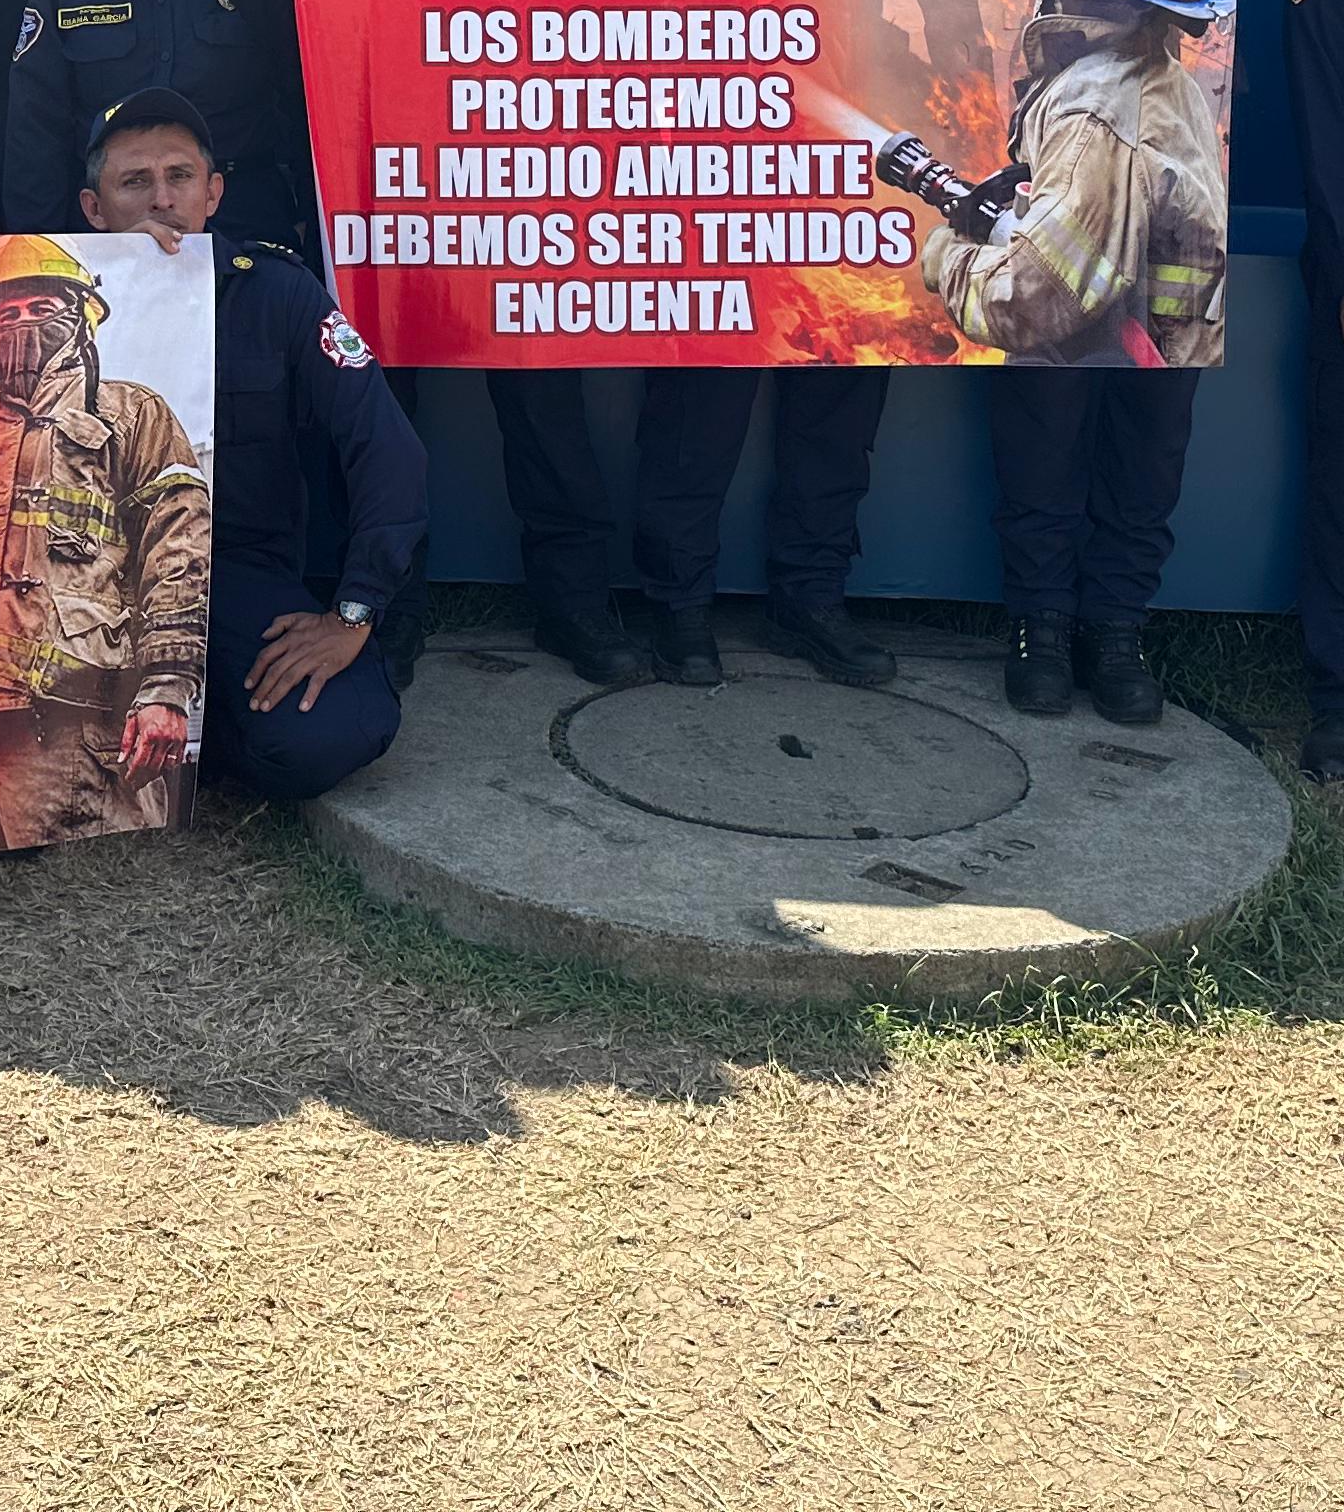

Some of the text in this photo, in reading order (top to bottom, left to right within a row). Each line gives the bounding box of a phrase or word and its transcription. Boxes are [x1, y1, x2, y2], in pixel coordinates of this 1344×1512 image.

[425, 8, 816, 64] LOS BOMBEROS
[451, 76, 791, 131] PROTEGEMOS
[375, 144, 869, 198] EL MEDIO AMBIENTE
[334, 209, 914, 267] DEBEMOS SER TENIDOS
[495, 280, 754, 333] ENCUENTA
